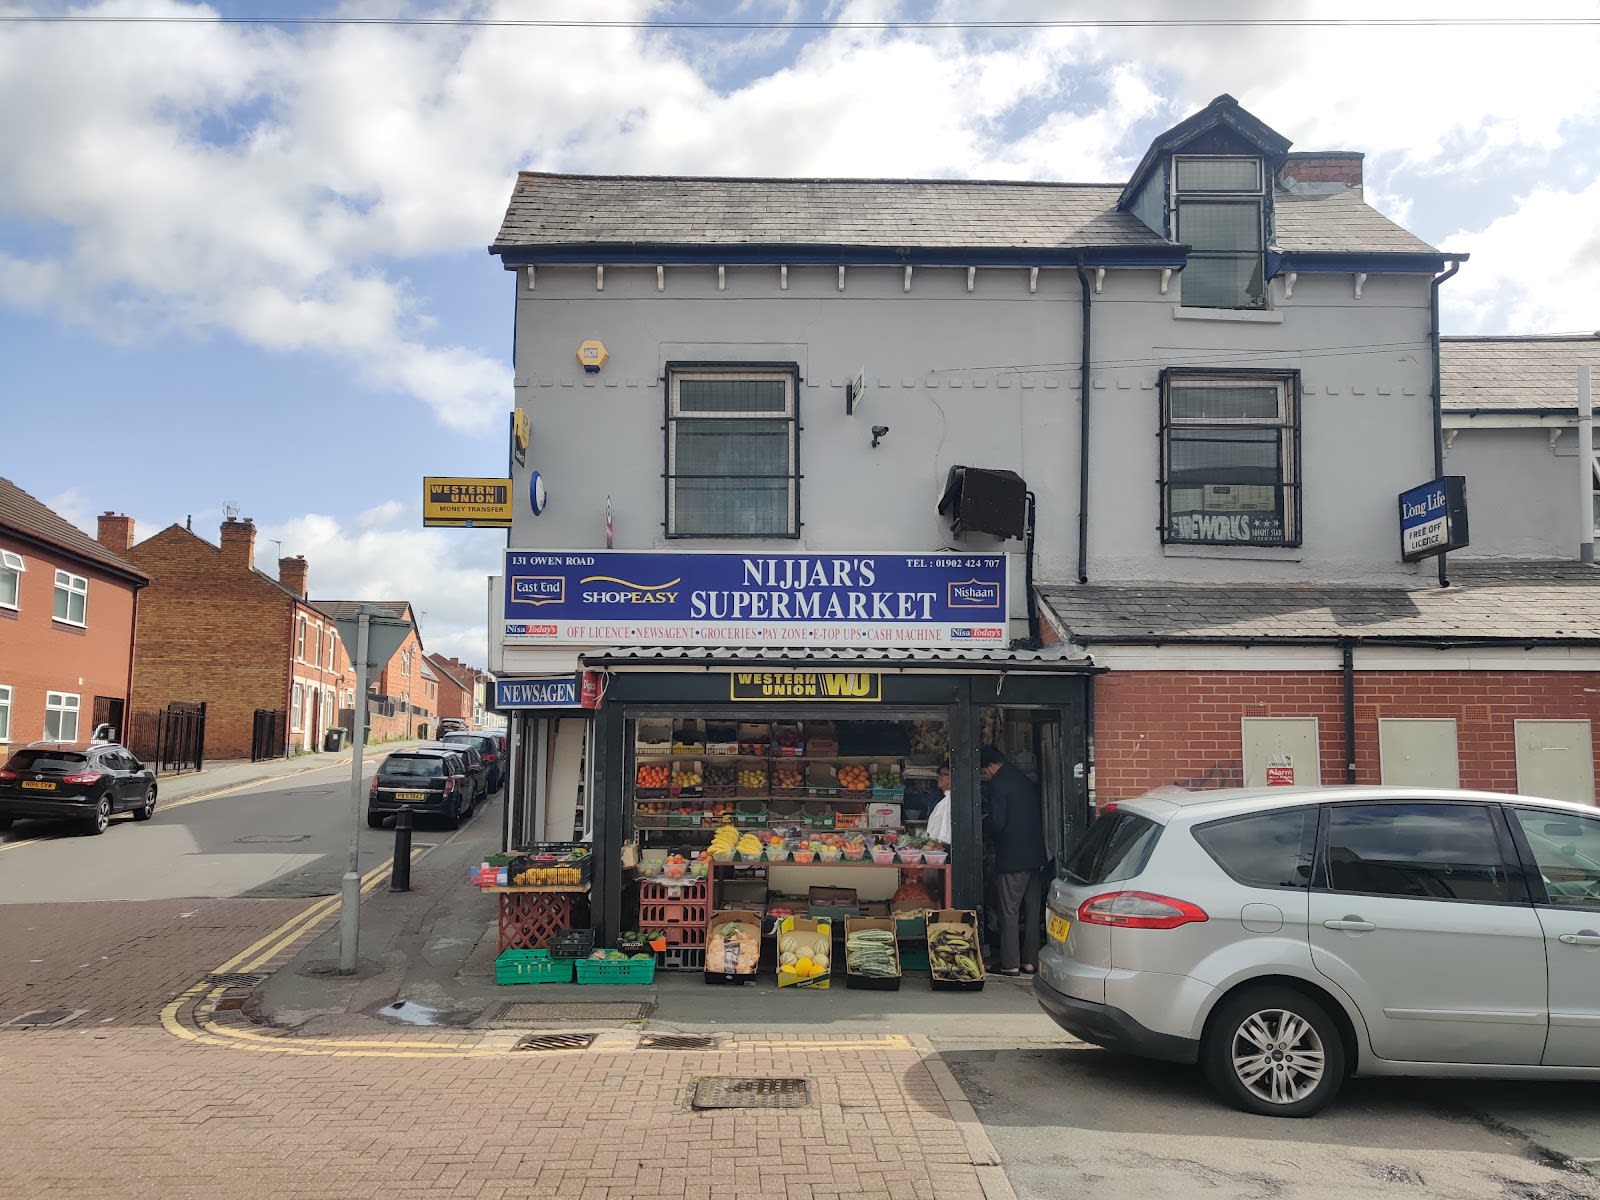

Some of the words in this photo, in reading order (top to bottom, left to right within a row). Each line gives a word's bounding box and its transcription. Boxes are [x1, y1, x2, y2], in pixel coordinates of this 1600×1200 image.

[431, 485, 494, 495] WESTERN
[451, 494, 494, 503] UNION
[1402, 501, 1426, 520] Long
[1427, 490, 1446, 511] Life
[1171, 514, 1250, 540] FIREWORKS
[1409, 526, 1427, 540] FREE
[1428, 521, 1442, 534] OFF
[1411, 534, 1439, 549] LICENCE
[512, 556, 527, 566] 131
[530, 556, 562, 566] OWEN
[565, 556, 595, 566] ROAD
[906, 559, 927, 568] TEL
[935, 559, 962, 568] 01902
[964, 559, 981, 568] 424
[984, 559, 1000, 568] 707
[742, 559, 876, 590] NIJJAR'S
[516, 581, 538, 593] East
[541, 581, 560, 593] End
[954, 586, 994, 599] Nishaan
[582, 591, 679, 604] SHOPEASY
[690, 591, 937, 620] SUPERMARKET
[506, 625, 526, 633] Nisa
[528, 625, 556, 635] Today's
[567, 626, 585, 638] OFF
[589, 626, 631, 638] LICENCE
[636, 627, 694, 639] NEWSAGENT
[701, 627, 756, 640] GROCERIES
[762, 628, 780, 640] PAY
[782, 628, 807, 640] ZONE
[813, 628, 841, 640] E-TOP
[843, 628, 862, 640] UPS
[867, 628, 894, 641] CASH
[896, 628, 942, 641] MACHINE
[952, 628, 971, 637] Nisa
[971, 628, 1003, 639] Today's
[738, 673, 816, 685] WESTERN
[825, 673, 870, 697] WU
[762, 684, 817, 696] UNION
[503, 684, 576, 703] NEWSAGEN
